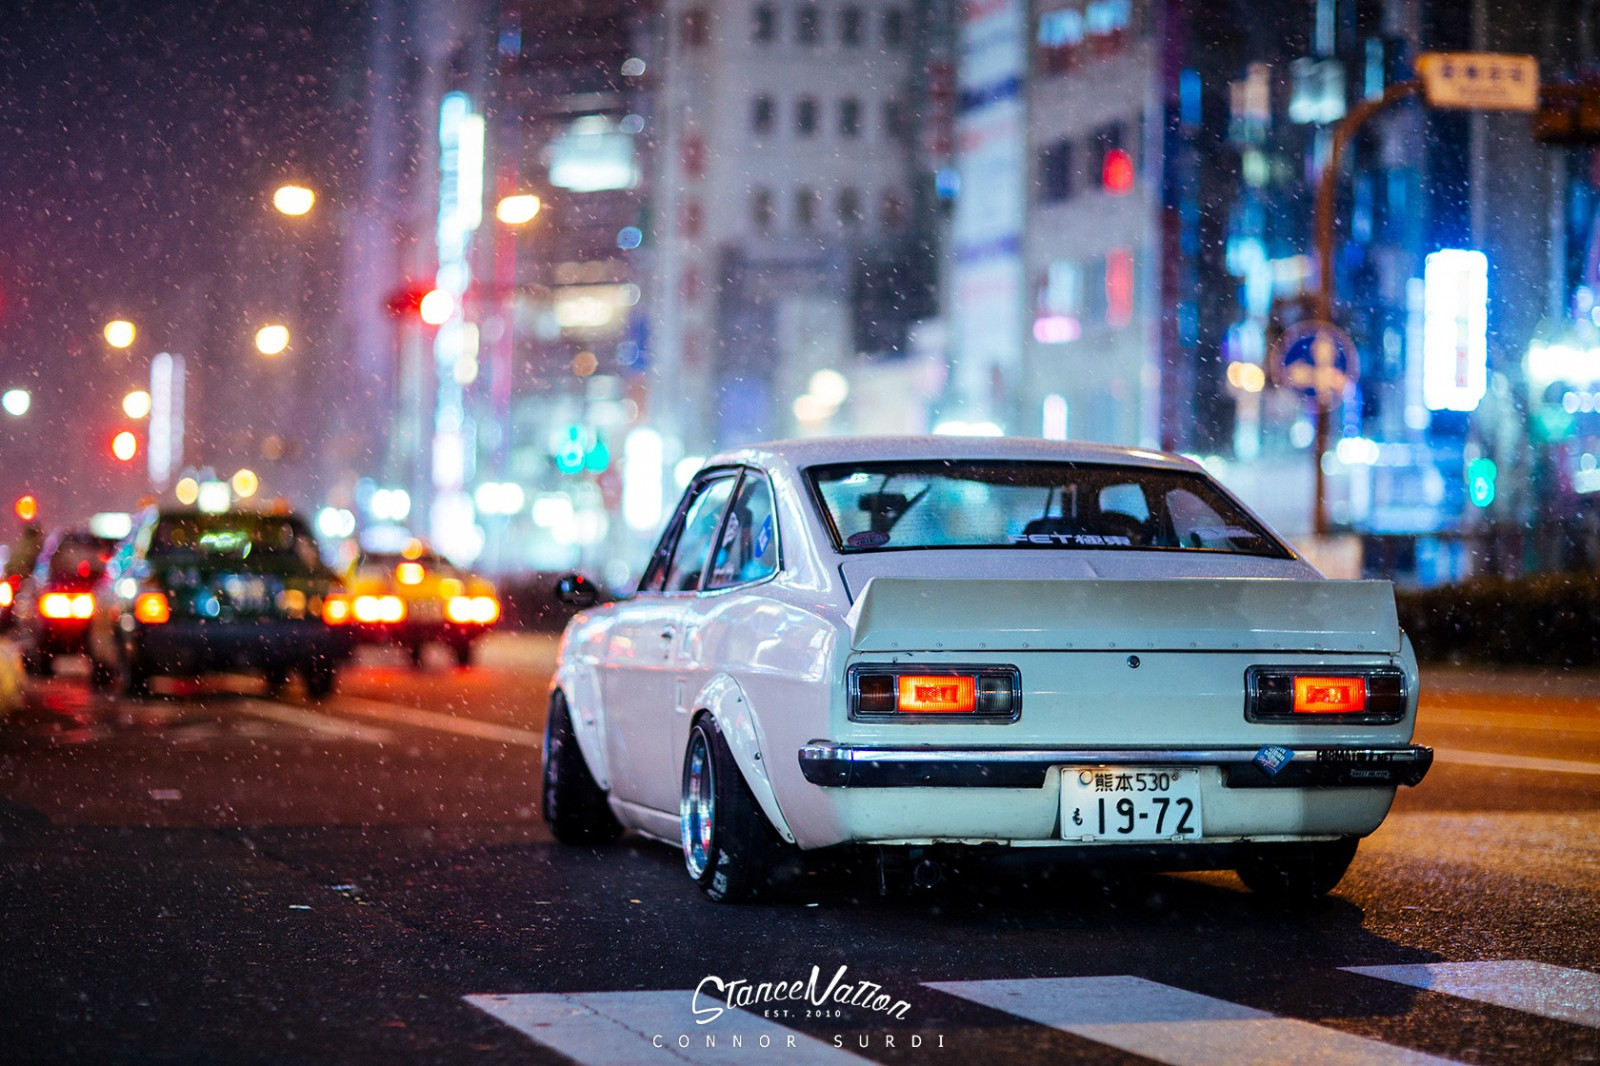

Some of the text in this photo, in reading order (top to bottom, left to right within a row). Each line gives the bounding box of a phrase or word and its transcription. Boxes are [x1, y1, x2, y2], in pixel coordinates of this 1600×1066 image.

[1094, 773, 1170, 792] 熊本530
[1072, 797, 1195, 834] も 19-72
